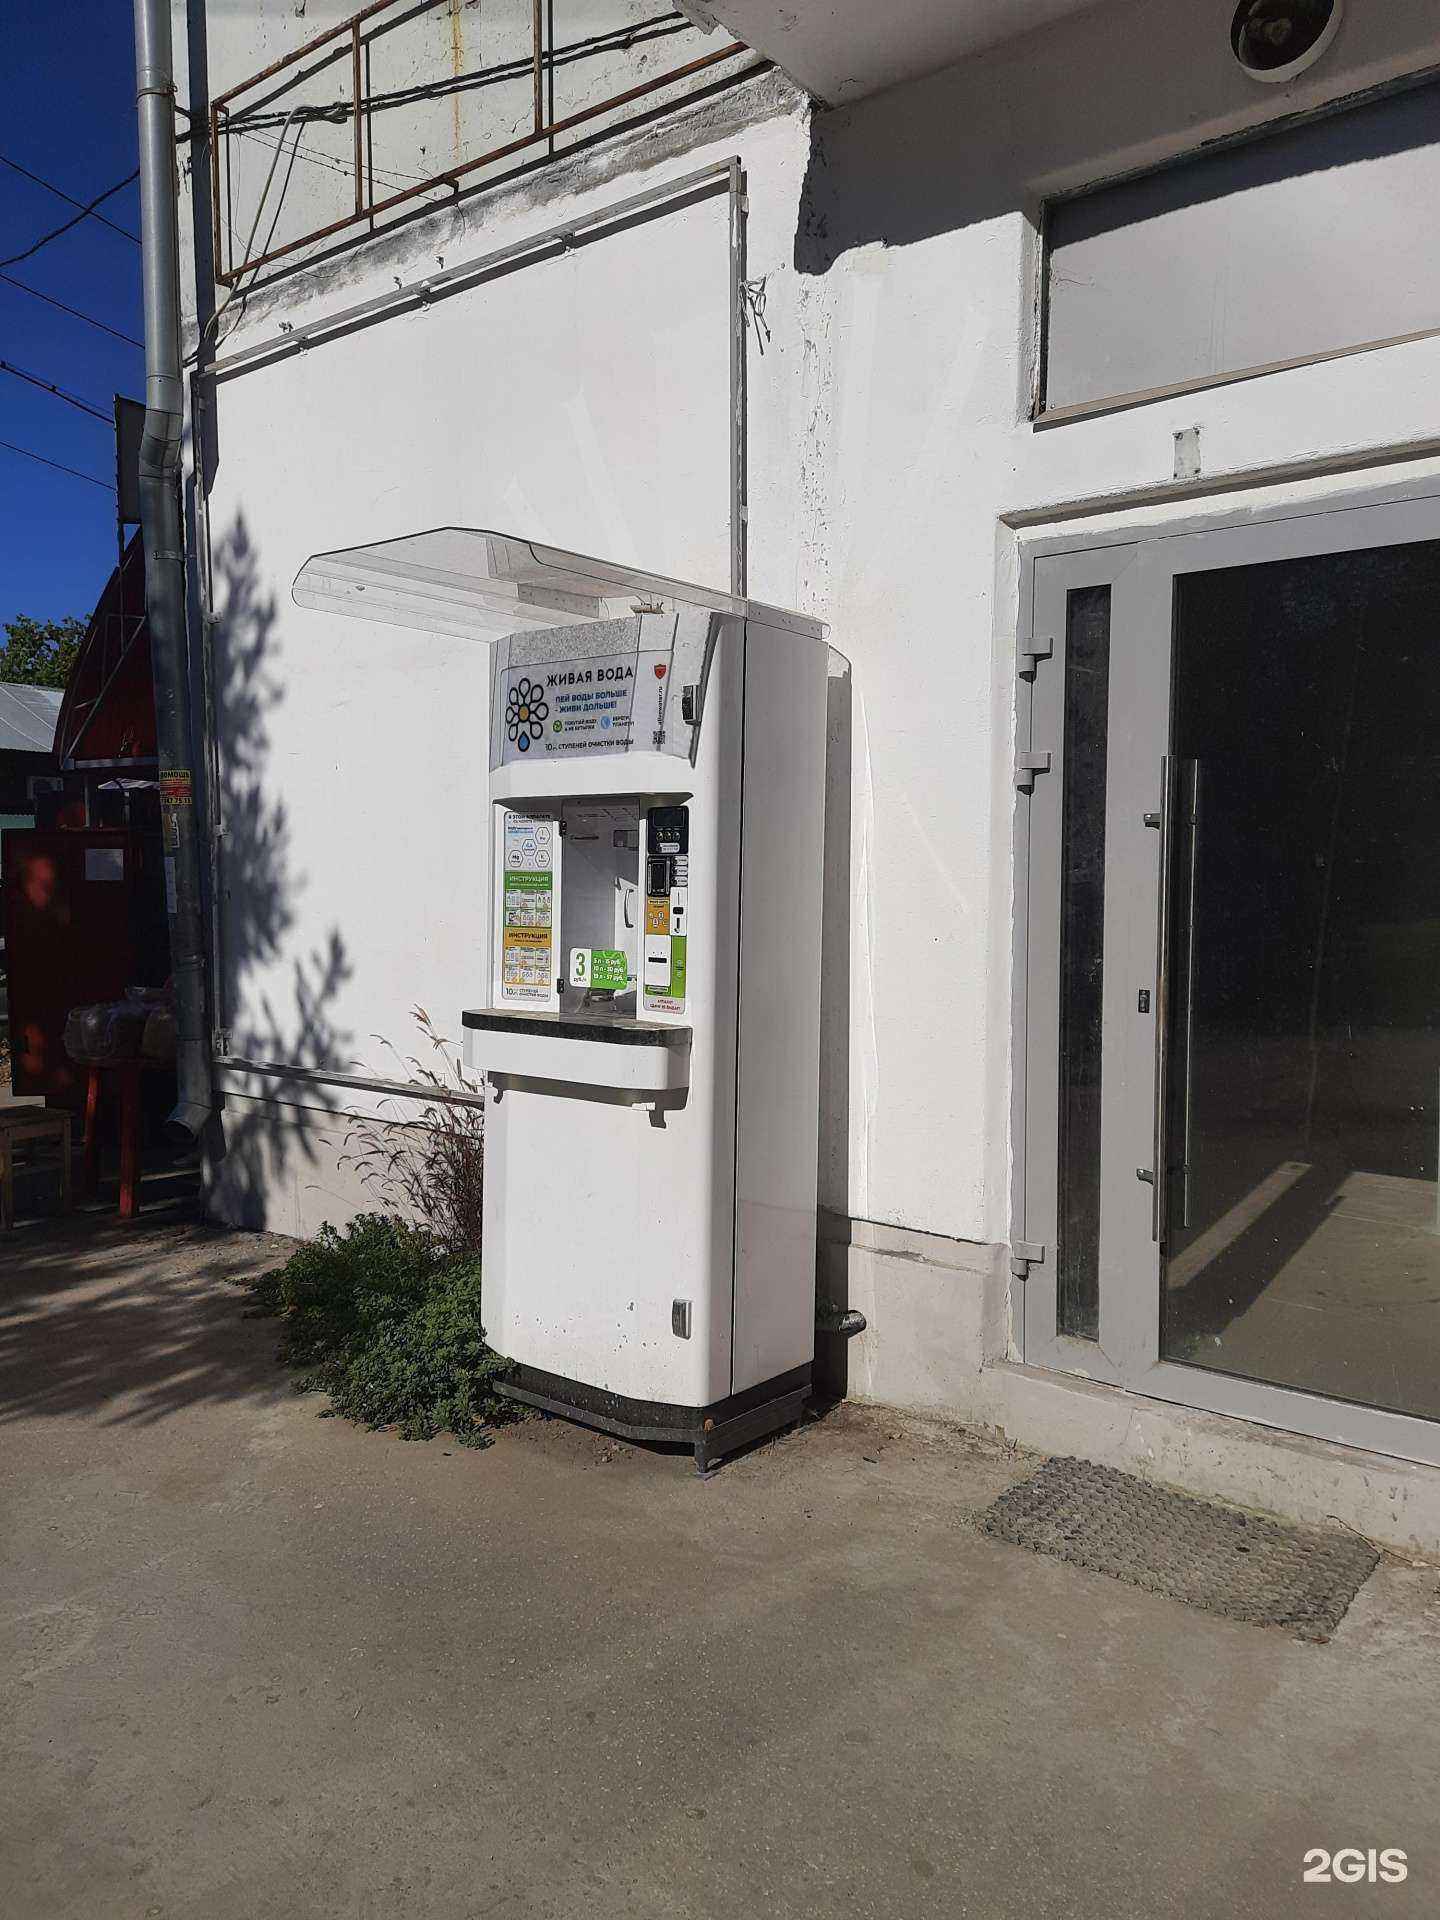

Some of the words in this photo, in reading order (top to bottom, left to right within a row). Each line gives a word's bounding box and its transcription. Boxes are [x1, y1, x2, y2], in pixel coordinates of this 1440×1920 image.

[546, 670, 593, 687] ЖИВАЯ
[597, 666, 634, 682] ВОДА
[555, 694, 570, 703] ПЕЙ
[571, 693, 594, 702] ВОДЫ
[595, 690, 628, 700] БОЛЬШЕ
[559, 704, 581, 714] ЖИВИ
[583, 701, 617, 712] ДОЛЬШЕ!
[558, 740, 587, 750] СТУПЕНЕЙ
[588, 740, 614, 748] ОЧИСТКИ
[508, 932, 548, 940] ИНСТРУКЦИЯ
[576, 952, 586, 976] 3
